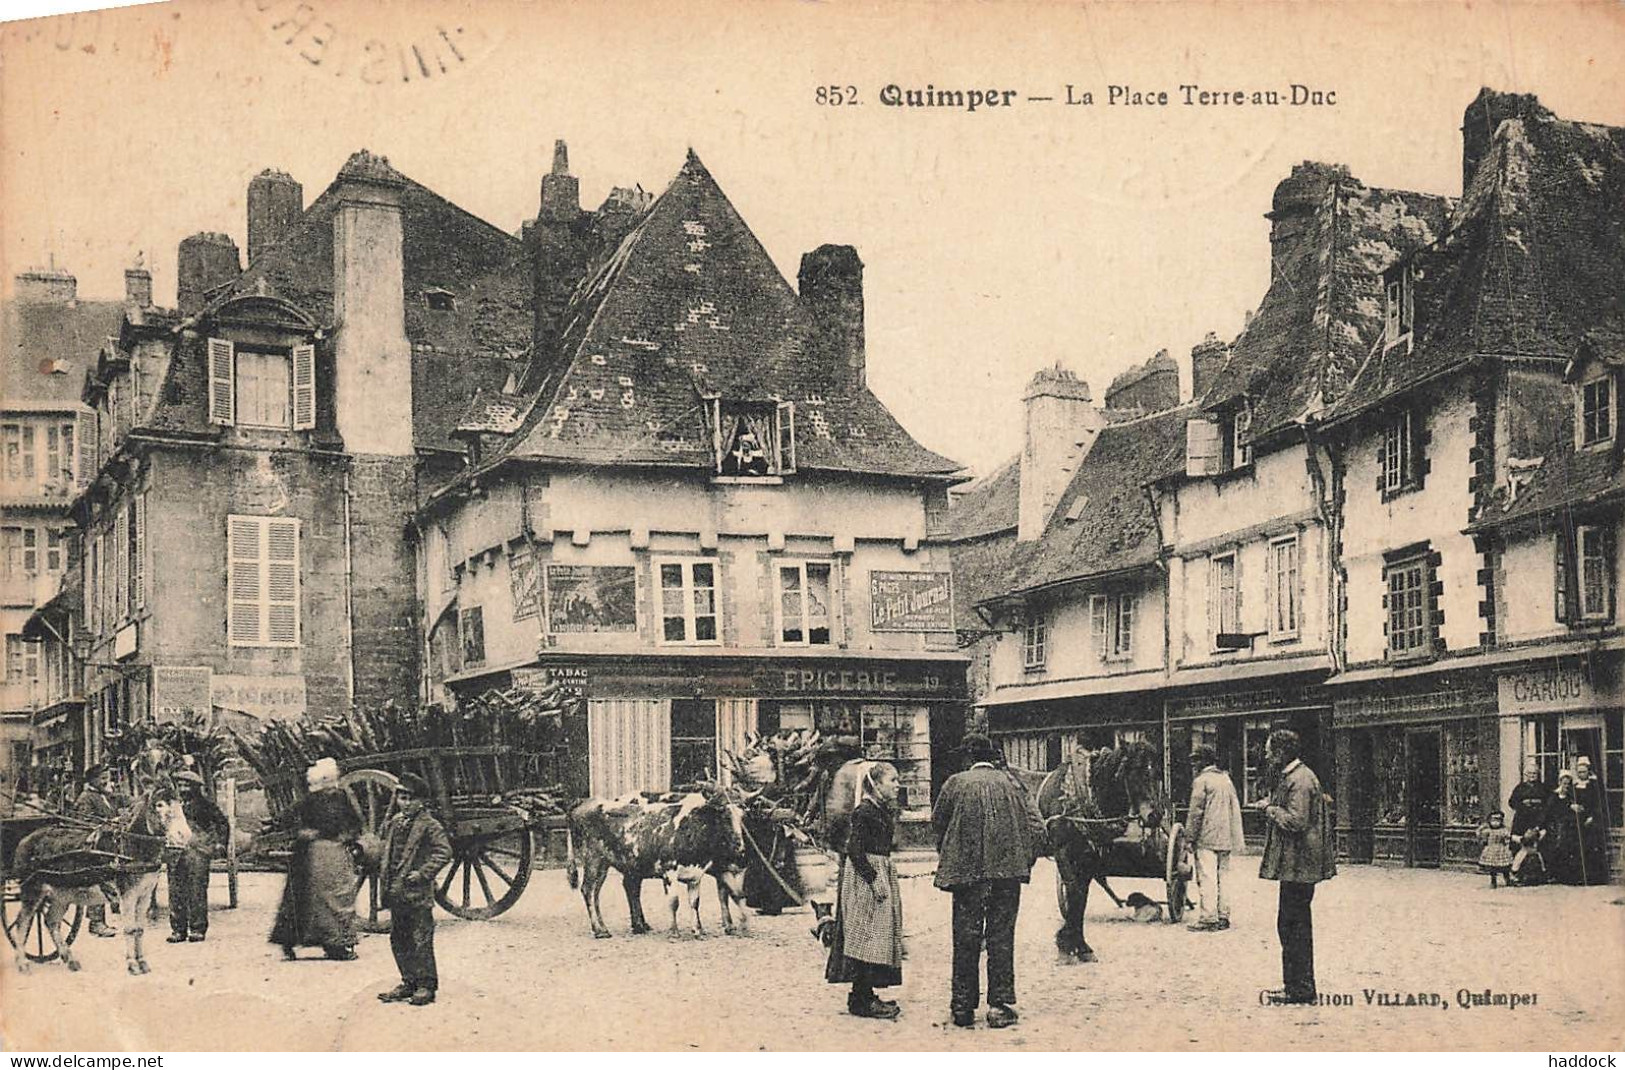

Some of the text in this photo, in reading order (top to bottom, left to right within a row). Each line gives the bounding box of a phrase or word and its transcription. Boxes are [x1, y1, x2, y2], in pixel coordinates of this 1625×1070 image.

[872, 577, 949, 626] Le Petit Journal
[549, 668, 588, 677] TABAC
